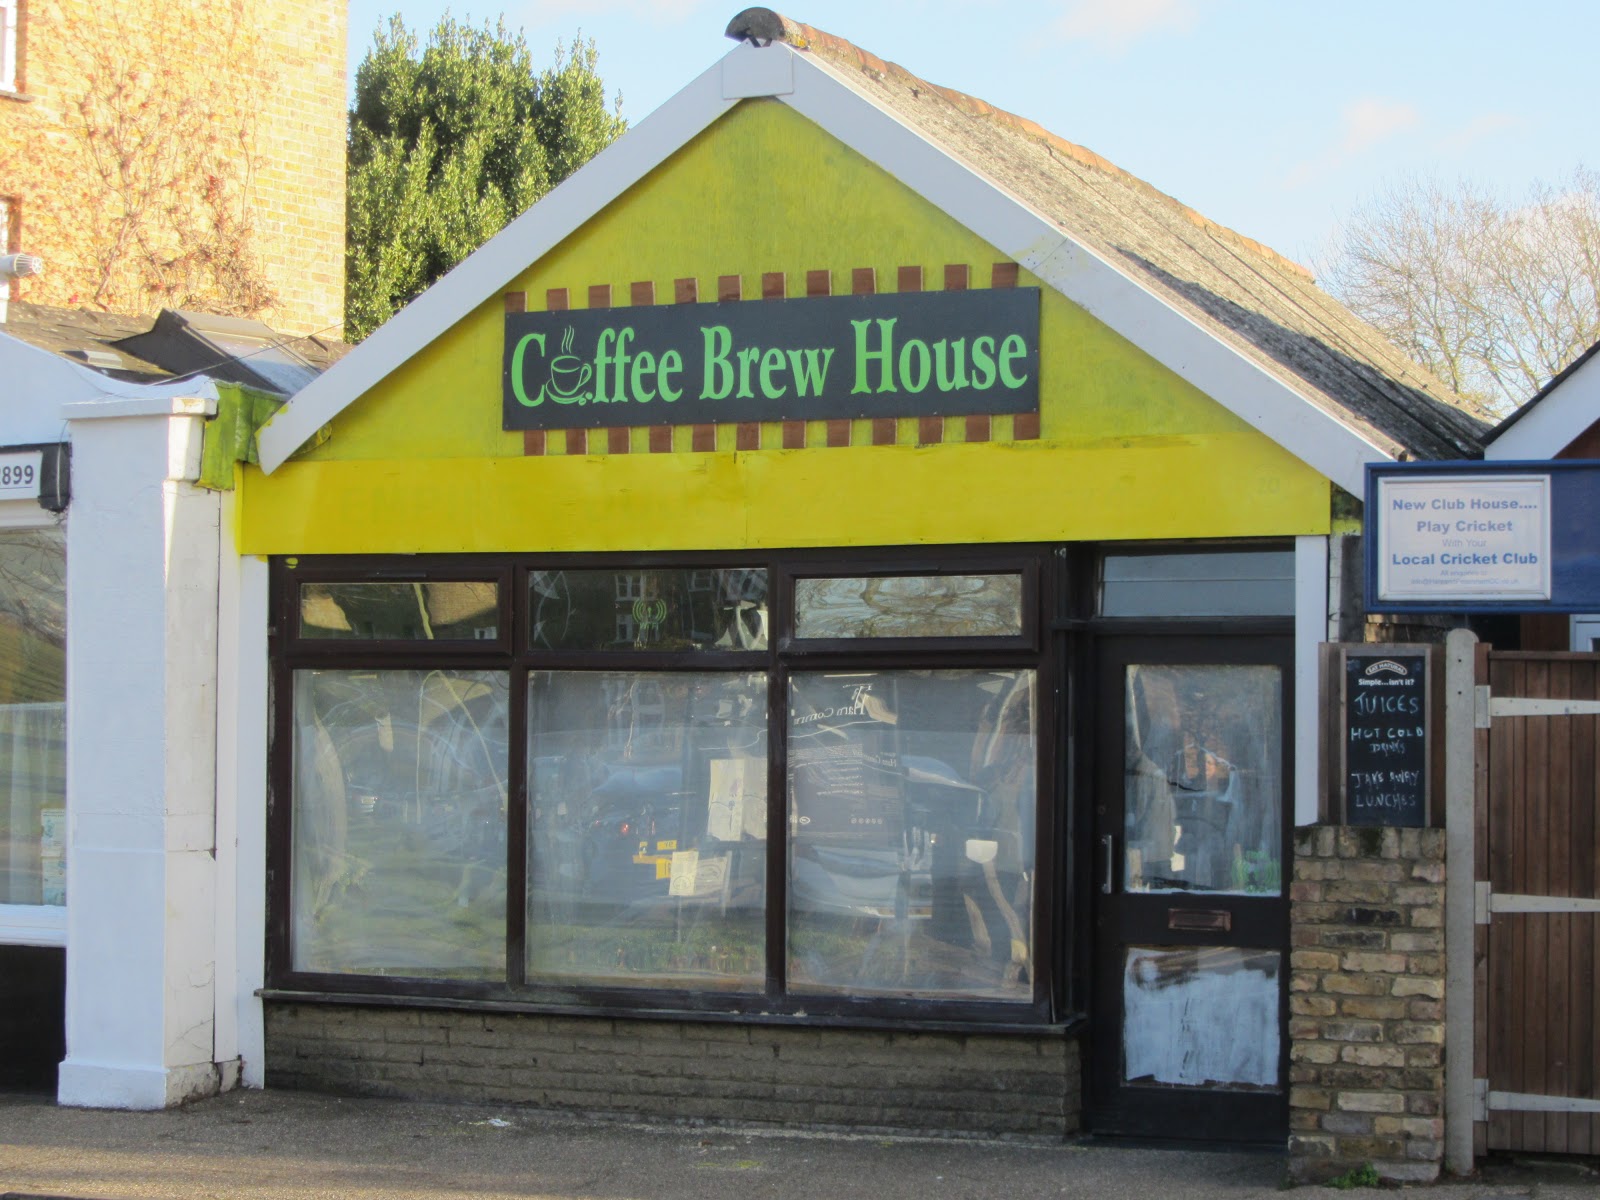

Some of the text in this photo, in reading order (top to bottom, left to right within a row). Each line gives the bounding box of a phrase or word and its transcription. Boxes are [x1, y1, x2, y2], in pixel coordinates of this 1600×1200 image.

[511, 317, 1028, 407] Coffee Brew House
[0, 465, 33, 485] 899
[1392, 499, 1426, 510] New
[1431, 498, 1465, 510] Club
[1416, 519, 1513, 535] Play Cricket
[1441, 538, 1487, 548] With Your
[1392, 552, 1538, 565] Local Cricket Club
[1354, 692, 1419, 716] JUICES
[1351, 727, 1424, 741] HOT COLD
[1355, 793, 1417, 810] LUNCHES
